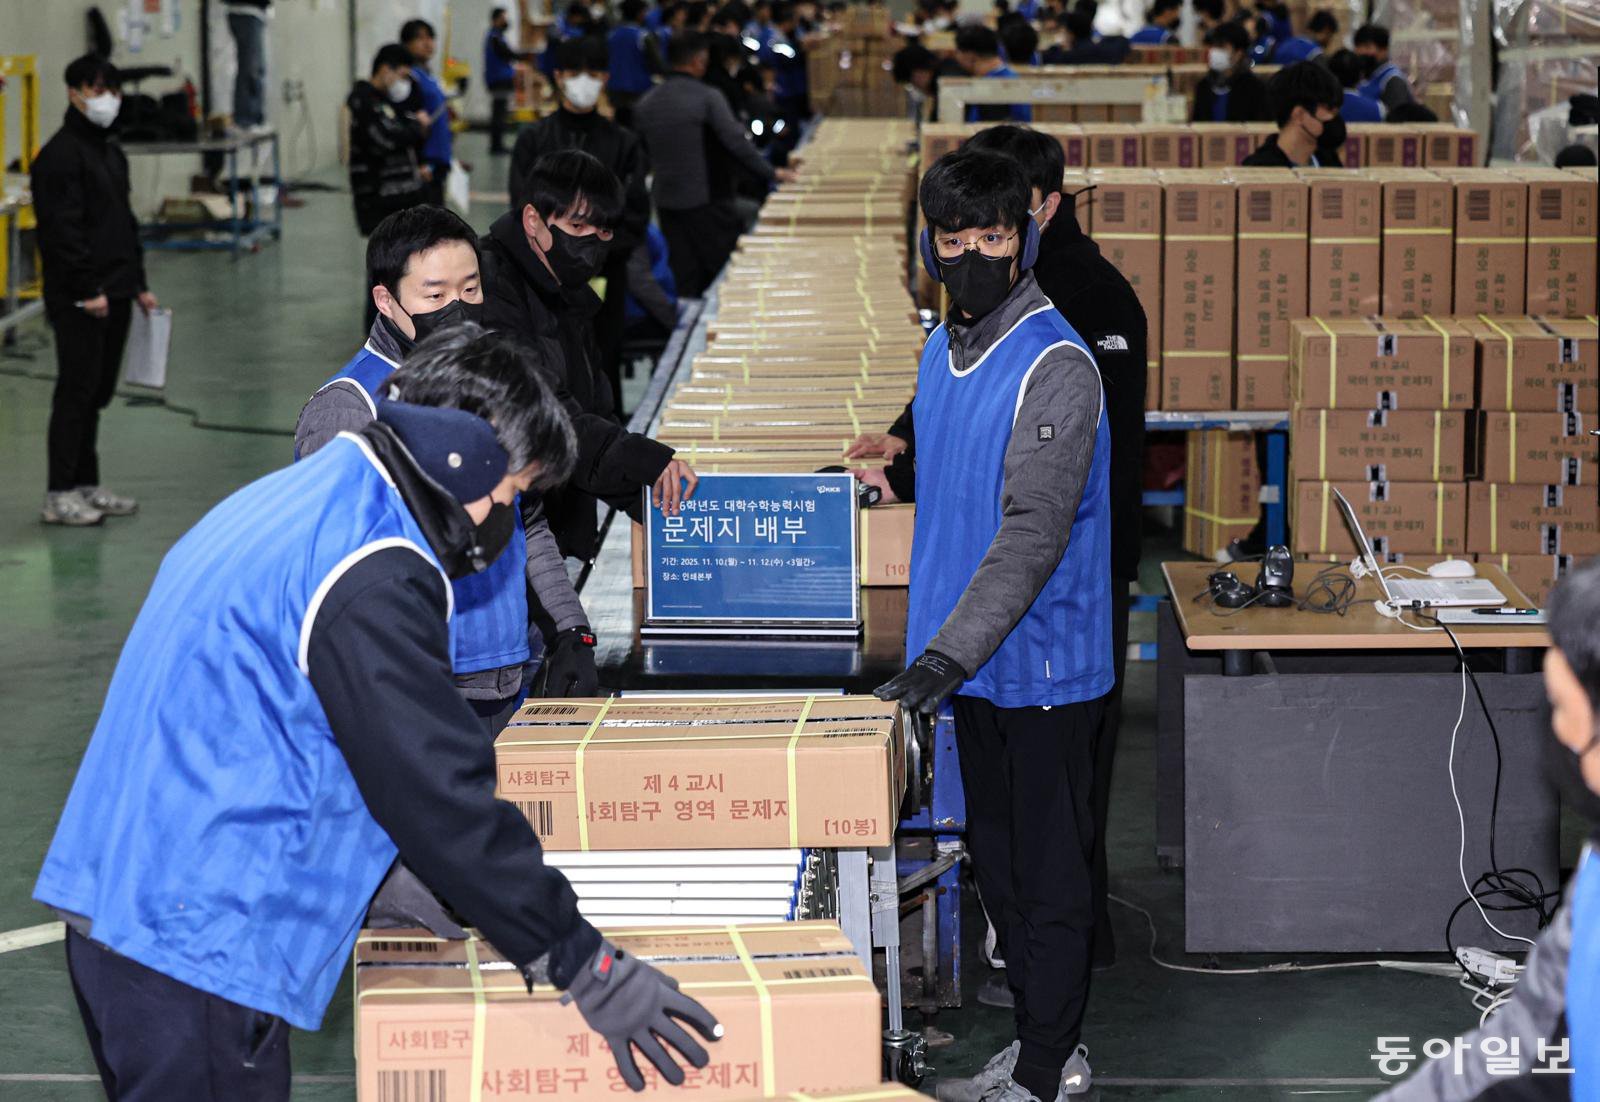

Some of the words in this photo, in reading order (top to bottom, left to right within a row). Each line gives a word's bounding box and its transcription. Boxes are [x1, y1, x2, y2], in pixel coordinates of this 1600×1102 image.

[1185, 248, 1197, 272] 국어
[1259, 247, 1271, 272] 국어
[1330, 247, 1342, 271] 국어
[1403, 247, 1416, 271] 국어
[1476, 247, 1489, 271] 국어
[1548, 246, 1560, 270] 국어
[1184, 280, 1197, 304] 영역
[1258, 280, 1271, 303] 영역
[1329, 278, 1342, 302] 영역
[1402, 278, 1415, 303] 영역
[1475, 278, 1488, 303] 영역
[1546, 277, 1560, 302] 영역
[1202, 300, 1214, 321] 교시
[1184, 312, 1197, 349] 문제지
[1258, 311, 1271, 348] 문제지
[1391, 360, 1410, 370] 교시
[1568, 363, 1586, 373] 교시
[1348, 375, 1369, 386] 국어
[1375, 375, 1395, 386] 영역
[1402, 375, 1433, 386] 문제지
[1525, 377, 1545, 388] 국어
[1381, 432, 1400, 442] 교시
[1571, 435, 1589, 446] 교시
[1338, 446, 1359, 458] 국어
[1364, 446, 1384, 458] 영역
[1392, 446, 1423, 458] 문제지
[1528, 450, 1548, 461] 국어
[660, 500, 720, 512] 6학년도
[724, 499, 816, 513] 대학수학능력시험
[1383, 505, 1402, 515] 교시
[1553, 506, 1572, 516] 교시
[661, 516, 740, 543] 문제지
[754, 516, 807, 544] 배부
[1393, 520, 1425, 531] 문제지
[1511, 520, 1530, 531] 국어
[661, 557, 678, 567] 기간:
[681, 558, 700, 566] 2025.
[702, 558, 713, 566] 11.
[747, 558, 759, 567] 11.
[662, 572, 679, 581] 장소:
[682, 572, 713, 582] 인쇄본부
[508, 770, 570, 786] 사회탐구
[643, 773, 662, 794] 제
[668, 775, 679, 791] 4
[686, 772, 724, 793] 교시
[674, 799, 715, 821] 영역
[729, 798, 788, 820] 문제지
[388, 1030, 472, 1050] 사회탐구
[566, 1033, 590, 1057] 제
[482, 1067, 588, 1094] 사회탐구
